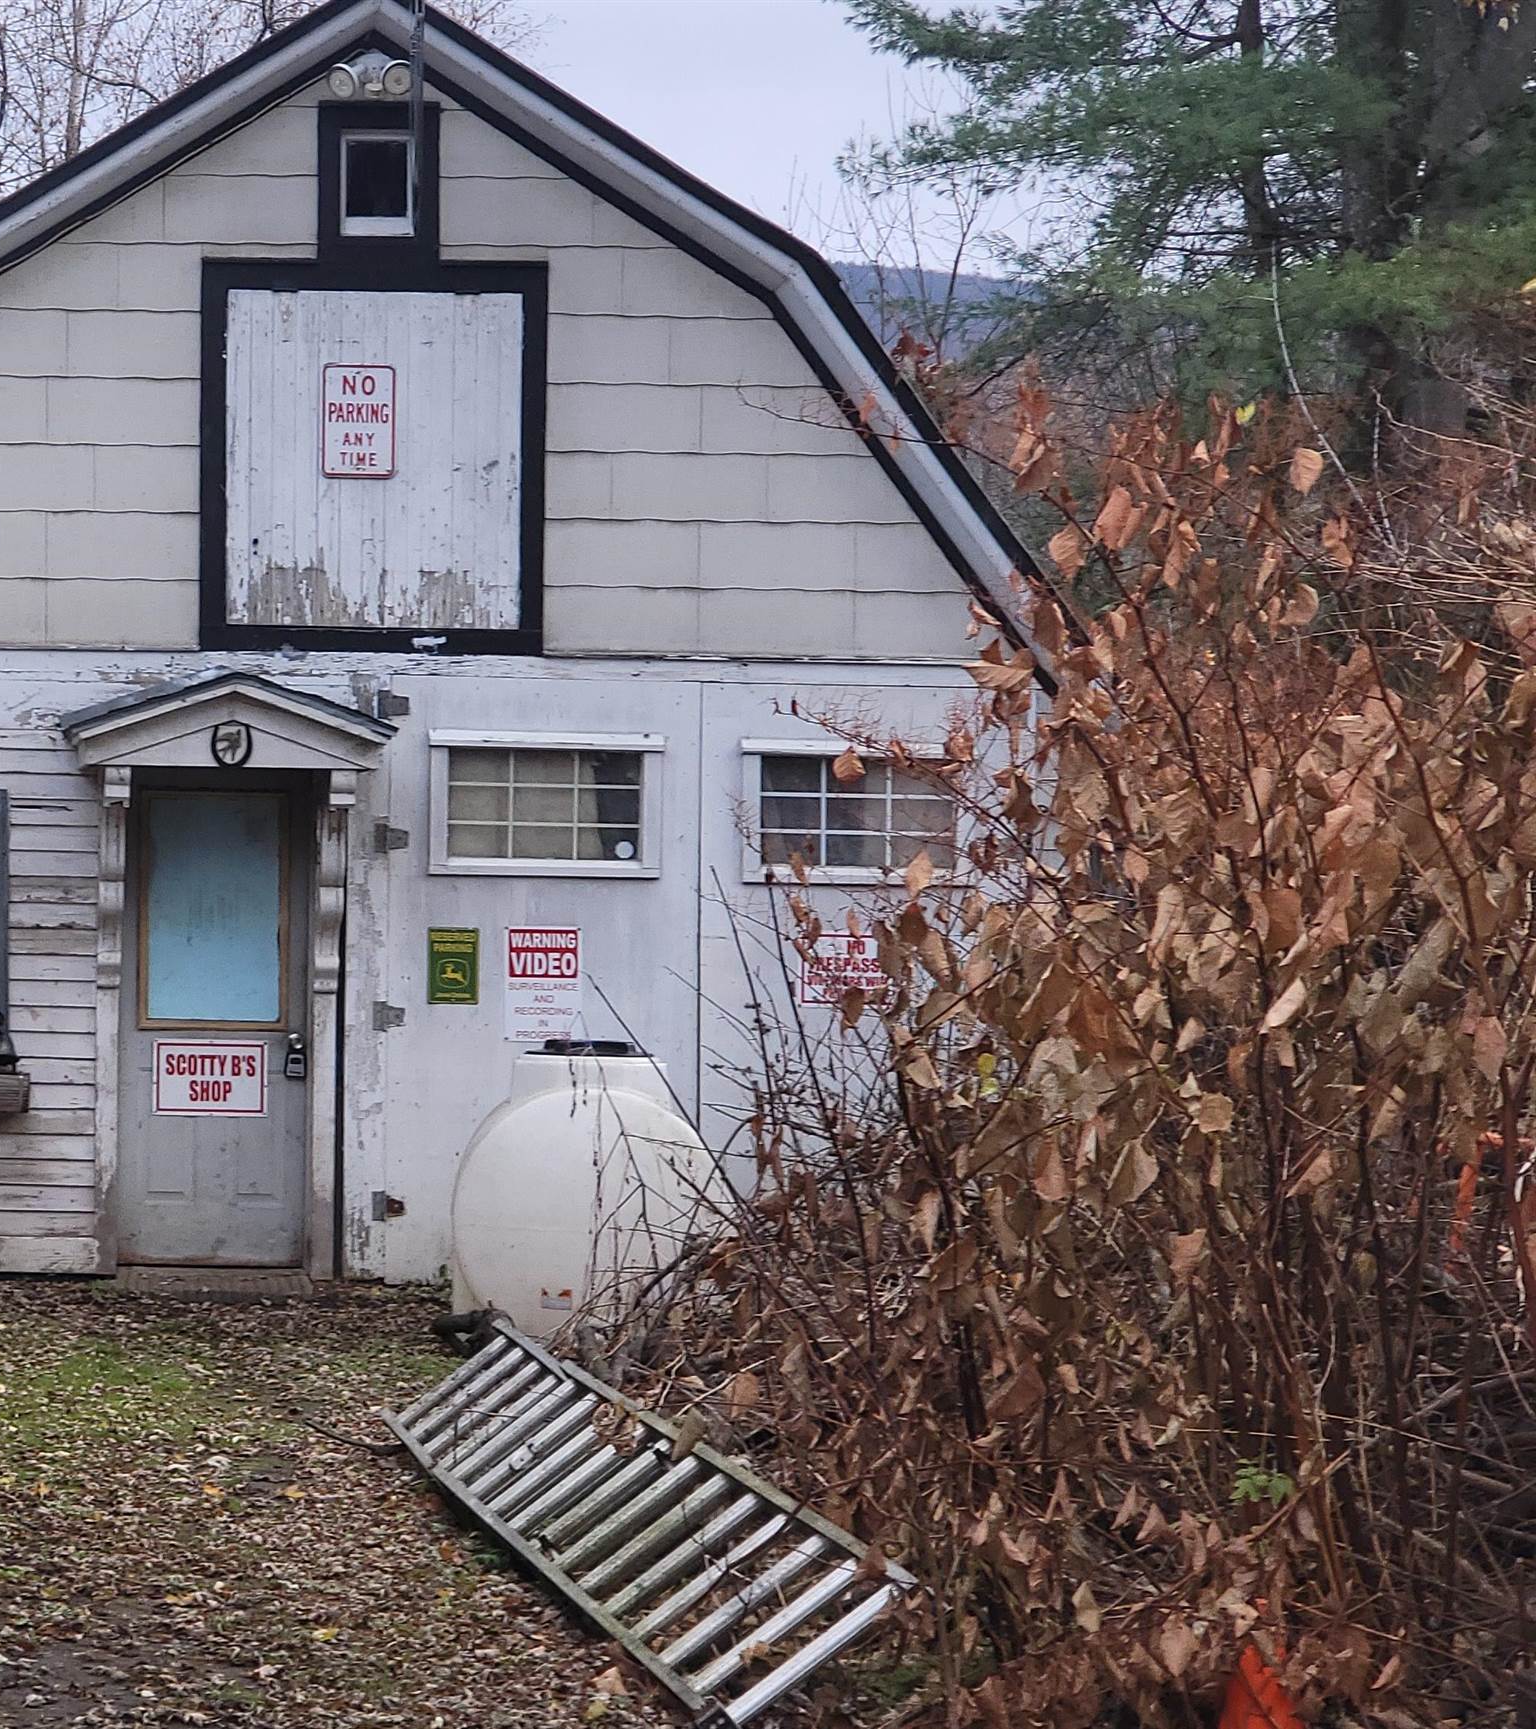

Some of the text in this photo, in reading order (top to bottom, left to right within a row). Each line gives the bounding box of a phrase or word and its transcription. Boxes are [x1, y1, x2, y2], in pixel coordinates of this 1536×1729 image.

[342, 375, 376, 396] NO
[328, 402, 390, 424] PARKING
[342, 432, 376, 447] ANY
[339, 452, 378, 467] TIME
[432, 943, 474, 953] PARKING
[510, 932, 577, 949] WARNING
[510, 952, 577, 976] VIDEO
[508, 982, 579, 991] SURVEILLANCE
[533, 995, 554, 1003] AND
[514, 1006, 573, 1015] RECORDING
[166, 1054, 256, 1077] SCOTTY B'S
[189, 1080, 232, 1102] SHOP
